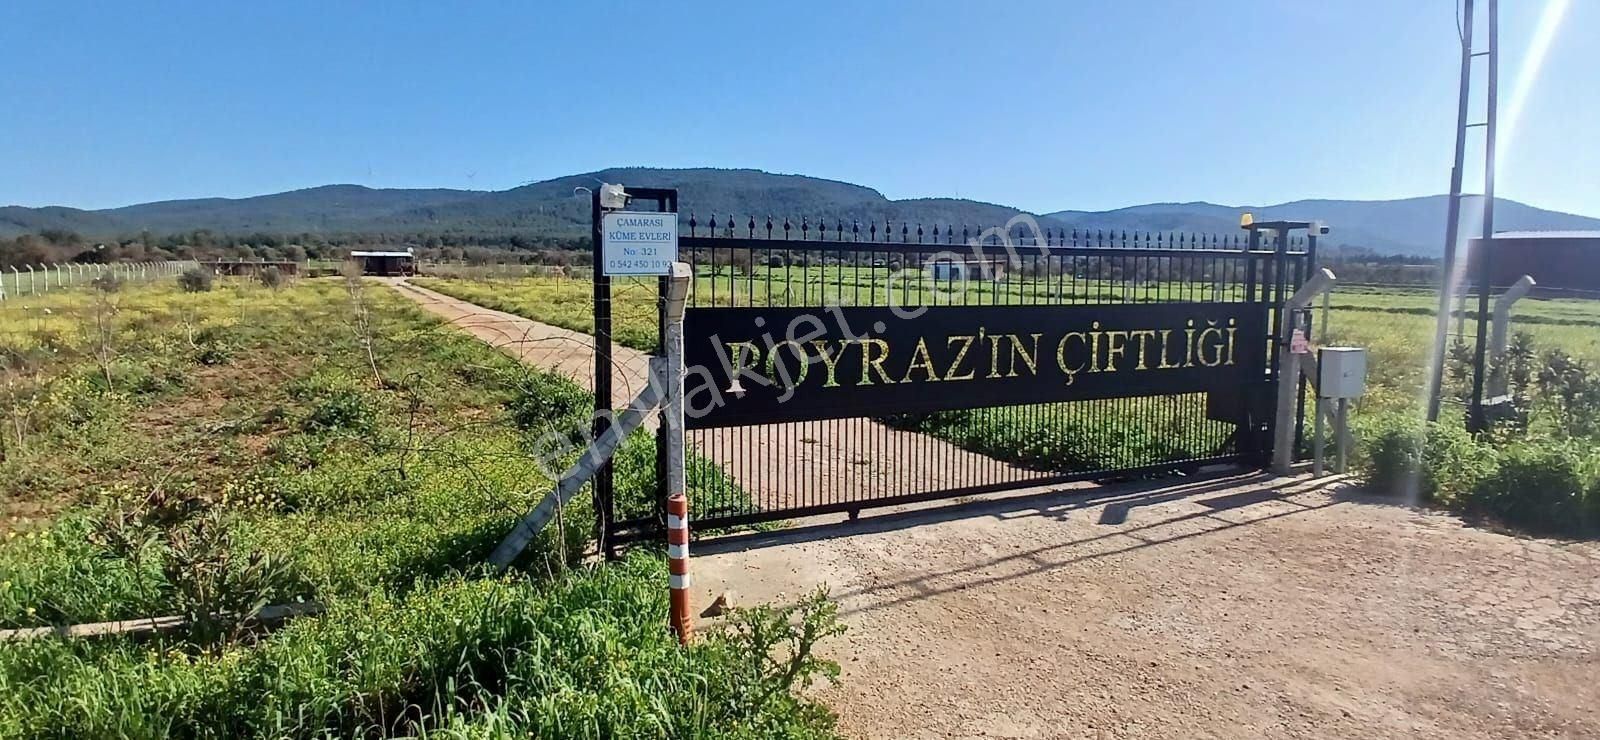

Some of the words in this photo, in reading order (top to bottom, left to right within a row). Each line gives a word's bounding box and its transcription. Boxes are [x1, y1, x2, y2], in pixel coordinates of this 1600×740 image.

[609, 231, 637, 240] KÜME
[639, 231, 671, 240] EVLERİ
[641, 247, 657, 256] 321
[609, 260, 616, 268] 0
[617, 260, 632, 268] 542
[634, 260, 649, 268] 450
[651, 260, 660, 269] 10
[725, 326, 1044, 393] POYRAZ'IN
[1056, 317, 1239, 386] ÇİFTLİĞİ
